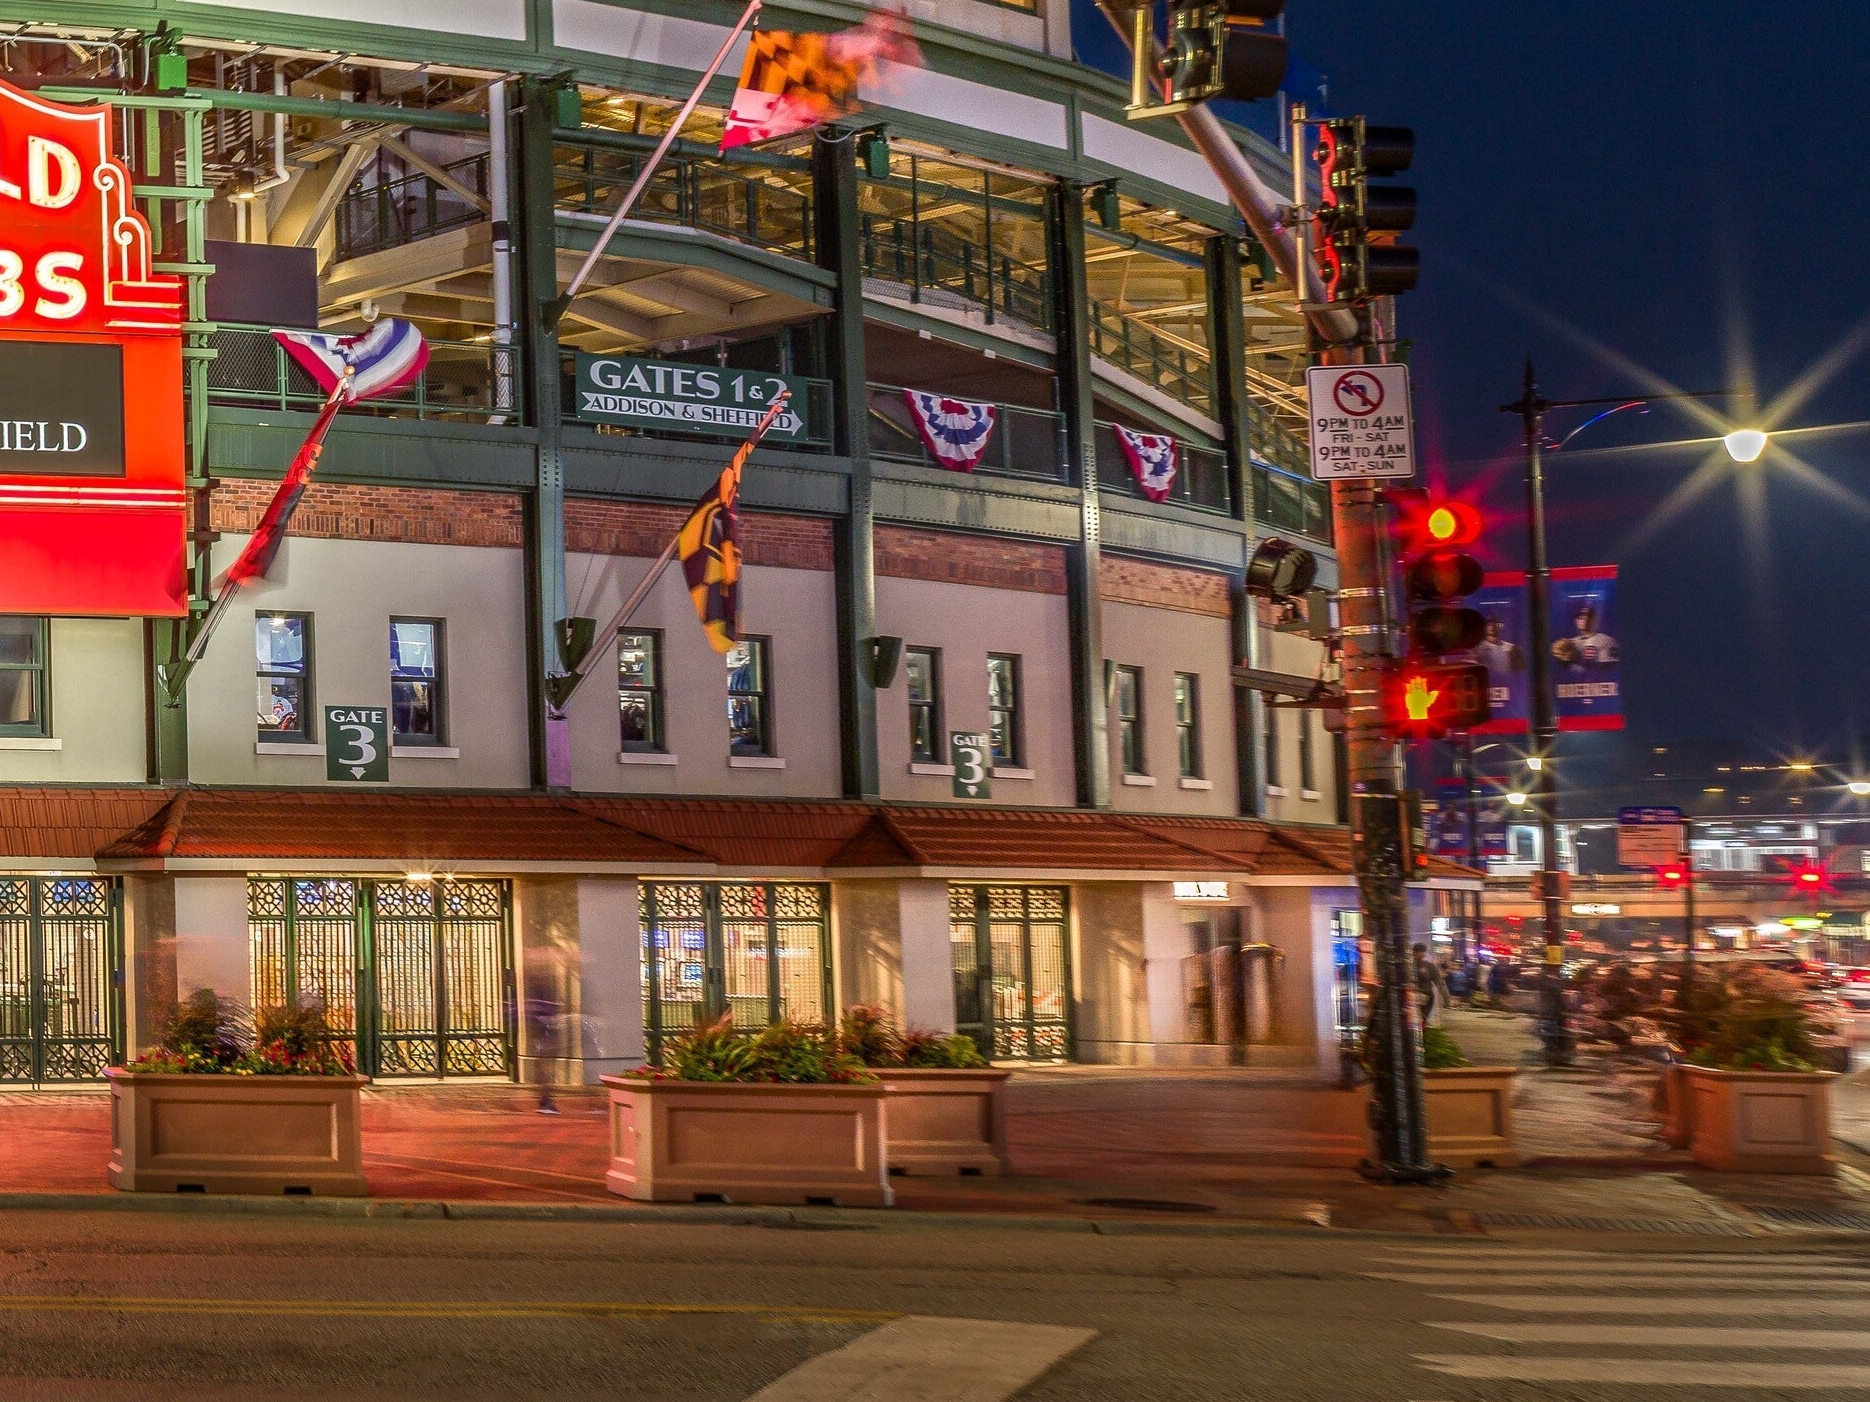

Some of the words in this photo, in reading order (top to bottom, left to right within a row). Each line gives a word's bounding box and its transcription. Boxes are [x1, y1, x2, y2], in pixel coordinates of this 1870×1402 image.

[589, 360, 721, 399] GATES
[590, 395, 677, 419] ADDISON
[681, 404, 695, 420] &
[701, 406, 792, 430] SHEFFID
[1317, 417, 1349, 433] 9PM
[1352, 418, 1369, 430] TO
[1372, 415, 1405, 430] 4AM
[1333, 433, 1354, 444] FRI
[1365, 432, 1390, 443] SAT
[1319, 446, 1351, 461] 9PM
[1354, 447, 1370, 458] TO
[1373, 444, 1407, 459] 4AM
[330, 709, 383, 724] GATE
[338, 724, 377, 765] 3
[953, 734, 988, 747] GATE
[959, 747, 985, 784] 3
